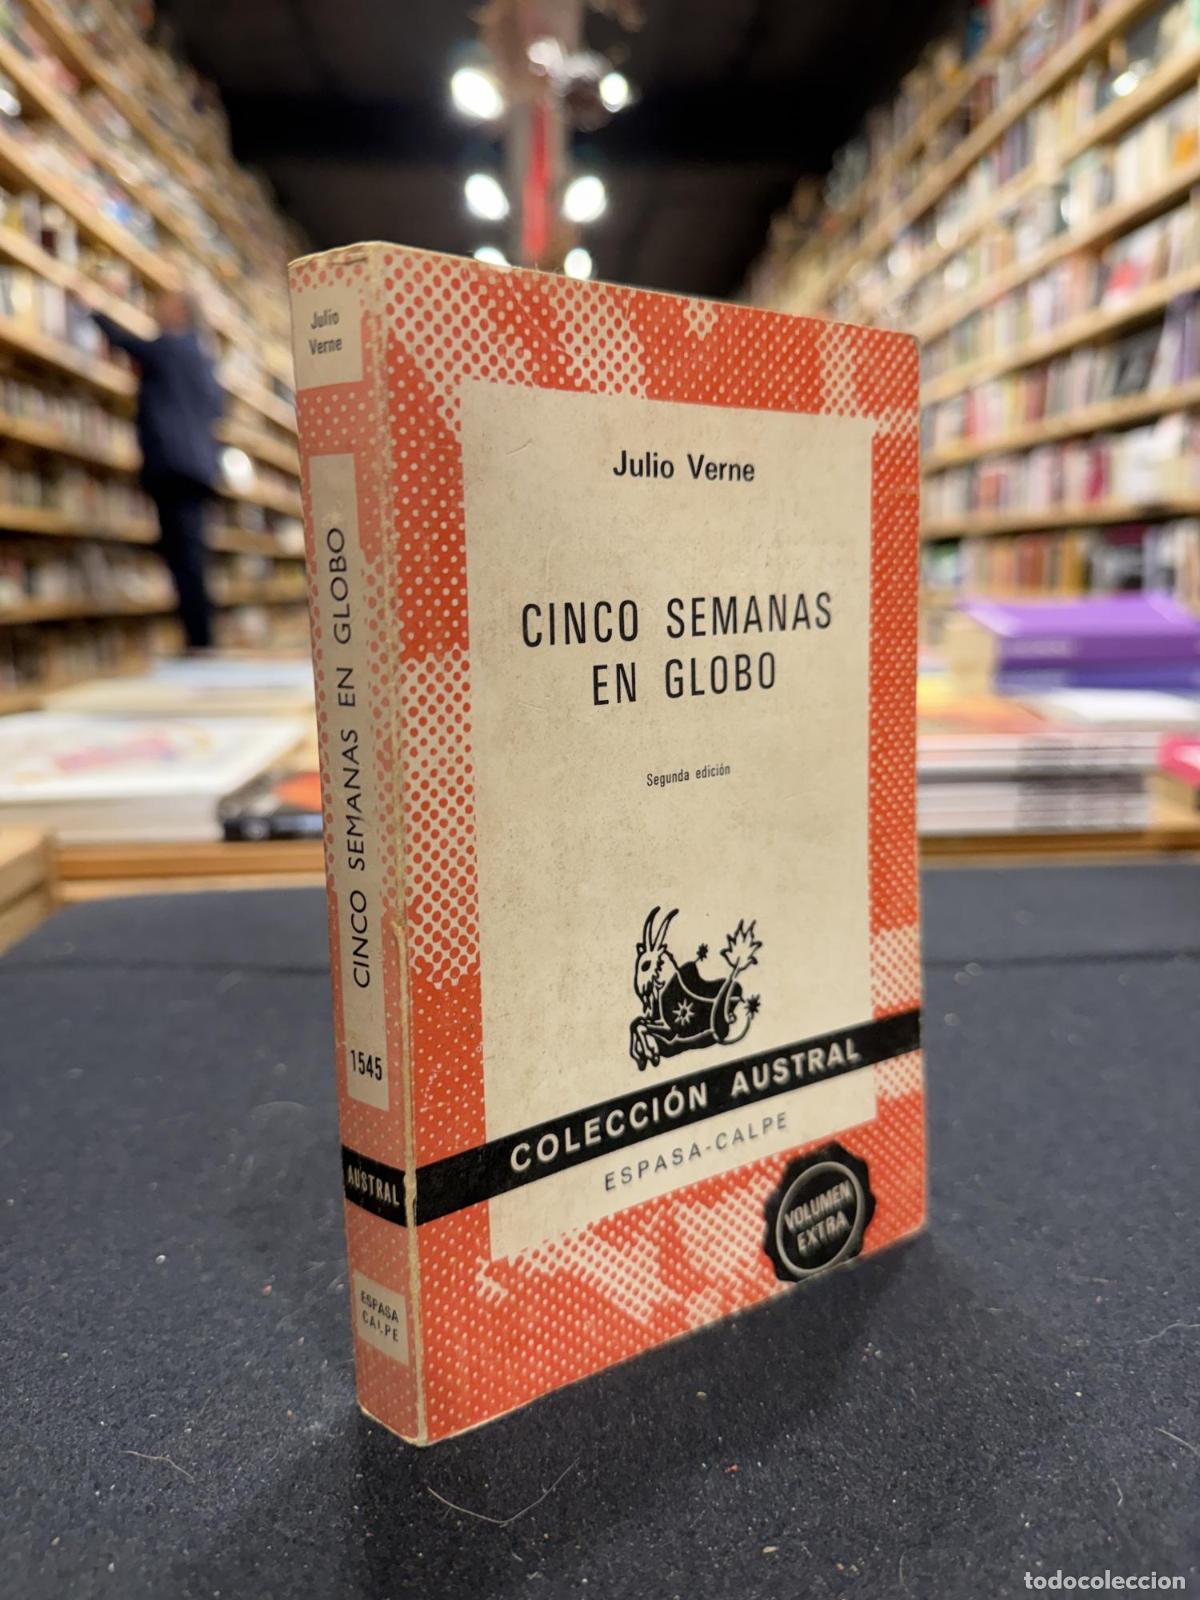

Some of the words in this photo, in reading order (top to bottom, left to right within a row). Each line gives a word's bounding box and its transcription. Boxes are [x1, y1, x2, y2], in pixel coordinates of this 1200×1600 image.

[310, 308, 340, 330] Julio
[309, 335, 343, 355] Verne
[612, 449, 675, 479] Julio
[686, 453, 756, 482] Verne
[326, 527, 352, 645] GLOBO
[521, 599, 639, 648] CINCO
[665, 591, 832, 639] SEMANAS
[337, 667, 355, 708] EN
[592, 661, 637, 706] EN
[664, 651, 776, 699] GLOBO
[646, 769, 690, 788] Segunda
[695, 763, 731, 780] edición
[340, 728, 365, 872] SEMANAS
[349, 889, 371, 989] CINCO
[350, 1049, 383, 1082] 1545
[508, 1080, 708, 1173] COLECCIÓN
[730, 1037, 862, 1097] AUSTRAL
[604, 1111, 789, 1192] ESPASA-CALPE
[347, 1164, 401, 1208] AUSTRAL
[783, 1179, 853, 1233] VOLUMEN
[796, 1212, 851, 1257] EXTRA
[360, 1289, 400, 1323] ESPASA
[361, 1309, 400, 1343] CALPE
